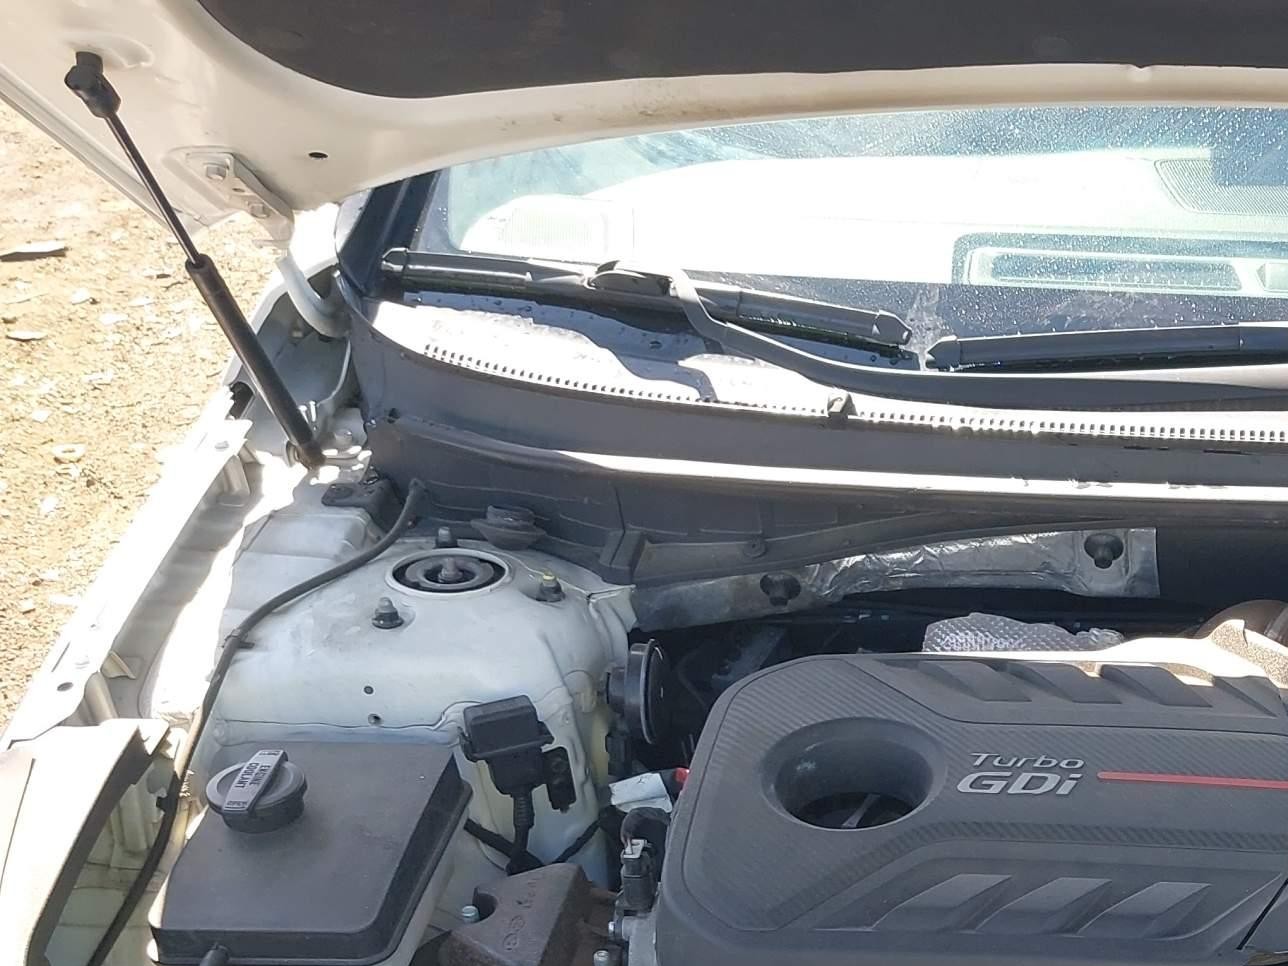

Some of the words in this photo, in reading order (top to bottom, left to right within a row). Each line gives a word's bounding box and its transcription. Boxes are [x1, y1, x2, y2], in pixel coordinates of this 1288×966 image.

[970, 752, 1085, 770] Turbo
[234, 762, 260, 789] COOLANT
[248, 764, 271, 786] ENGINE
[956, 771, 1083, 796] GDi
